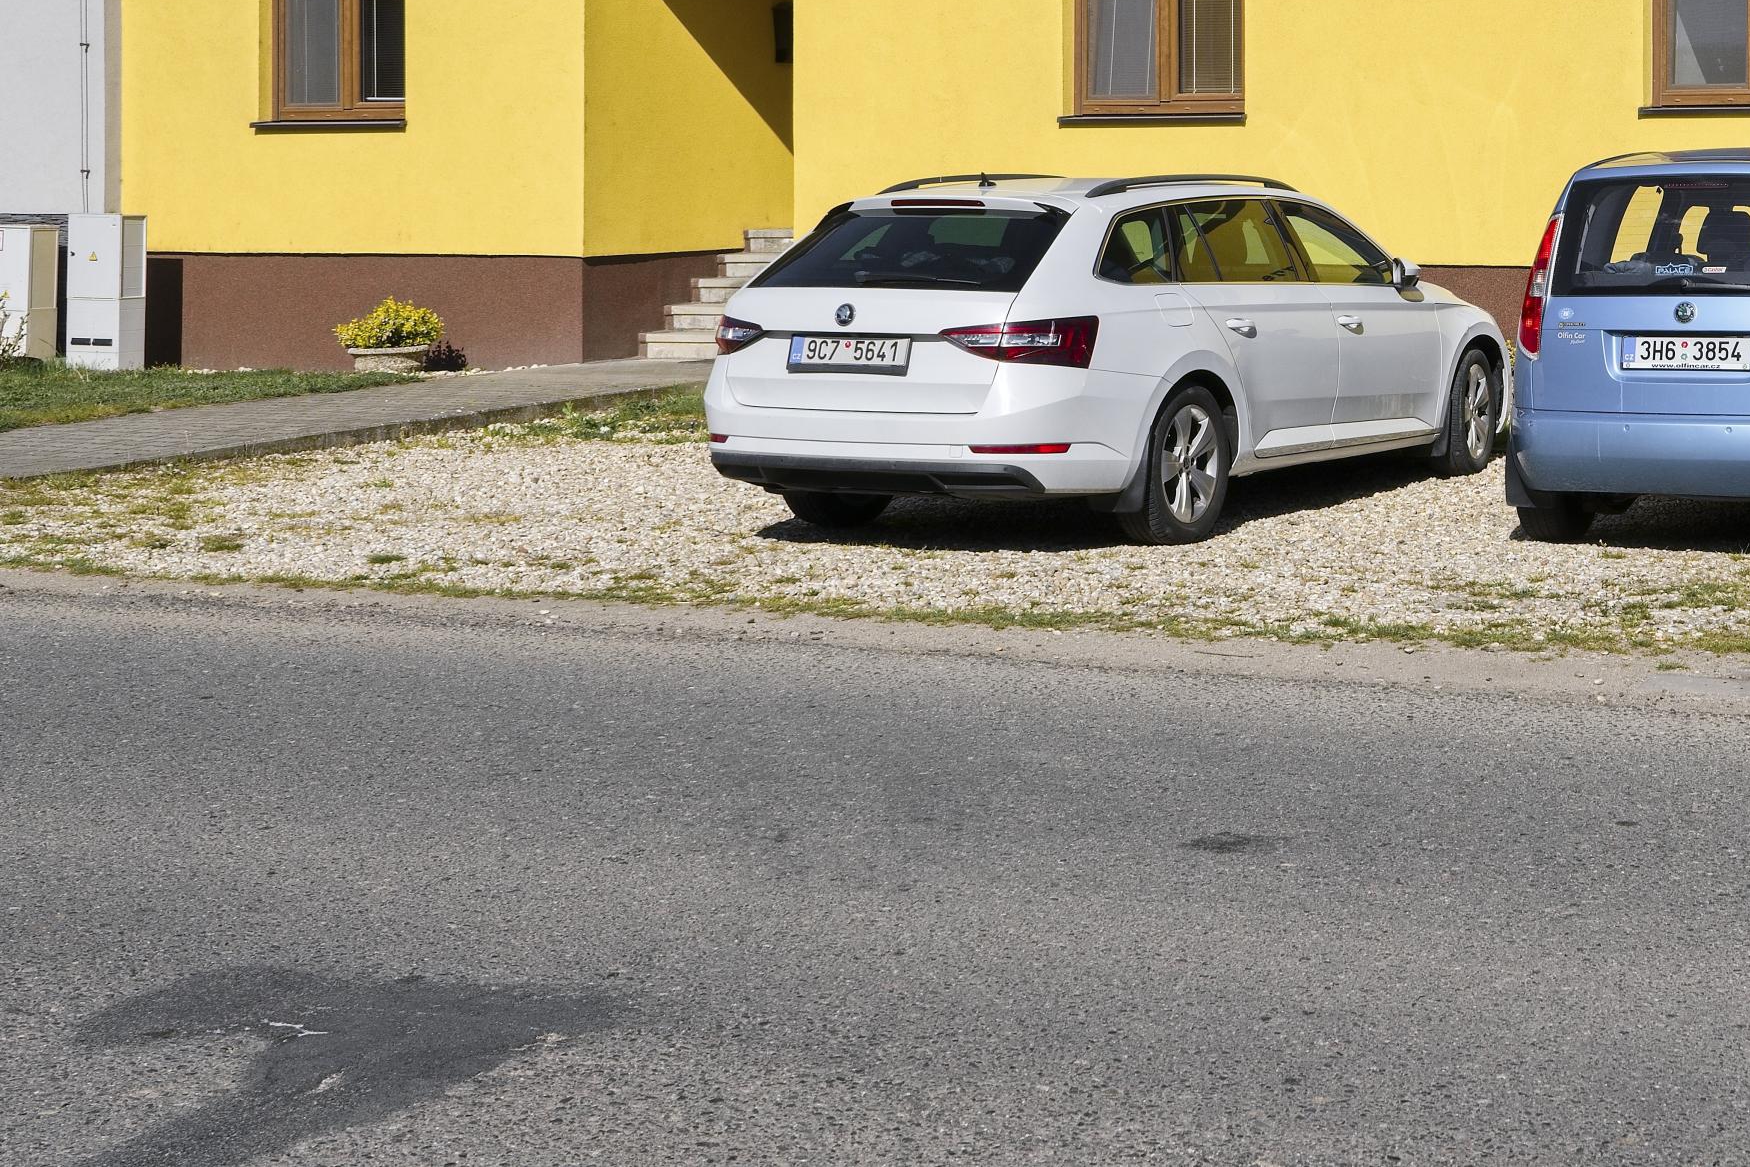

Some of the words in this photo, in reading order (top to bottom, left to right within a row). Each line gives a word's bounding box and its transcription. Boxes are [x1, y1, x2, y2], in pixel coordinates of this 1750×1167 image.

[1557, 331, 1573, 339] Olfin
[806, 339, 840, 361] 9C7
[853, 340, 899, 362] 5641
[1640, 340, 1676, 361] 3H6
[1692, 341, 1742, 362] 3854
